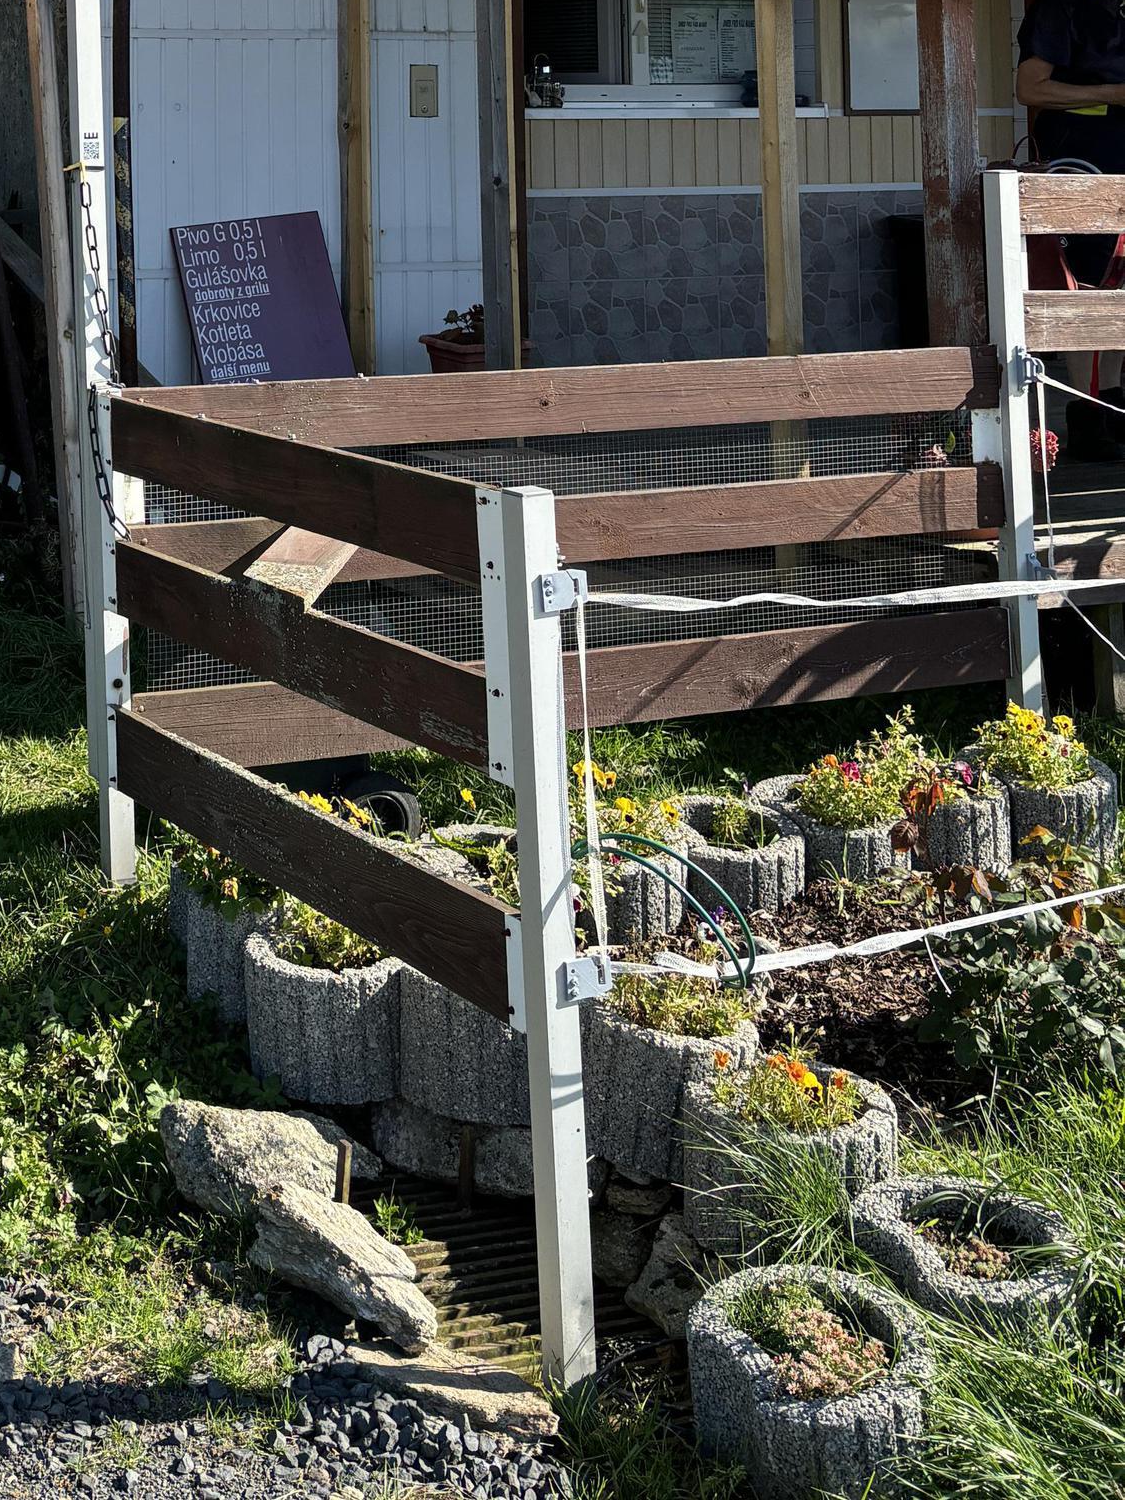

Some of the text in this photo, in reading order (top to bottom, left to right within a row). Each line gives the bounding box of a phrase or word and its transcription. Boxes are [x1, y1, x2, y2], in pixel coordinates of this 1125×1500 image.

[176, 226, 209, 247] Pivo
[213, 223, 226, 243] G
[229, 220, 254, 242] 0,5
[180, 247, 220, 268] Limo
[233, 241, 258, 262] 0,5
[185, 262, 268, 289] Gulášovka
[194, 286, 235, 302] dobroty
[236, 286, 243, 297] z
[192, 301, 261, 325] Krkovice
[196, 323, 252, 345] Kotleta
[200, 341, 265, 366] Klobása
[210, 361, 270, 379] další menu
